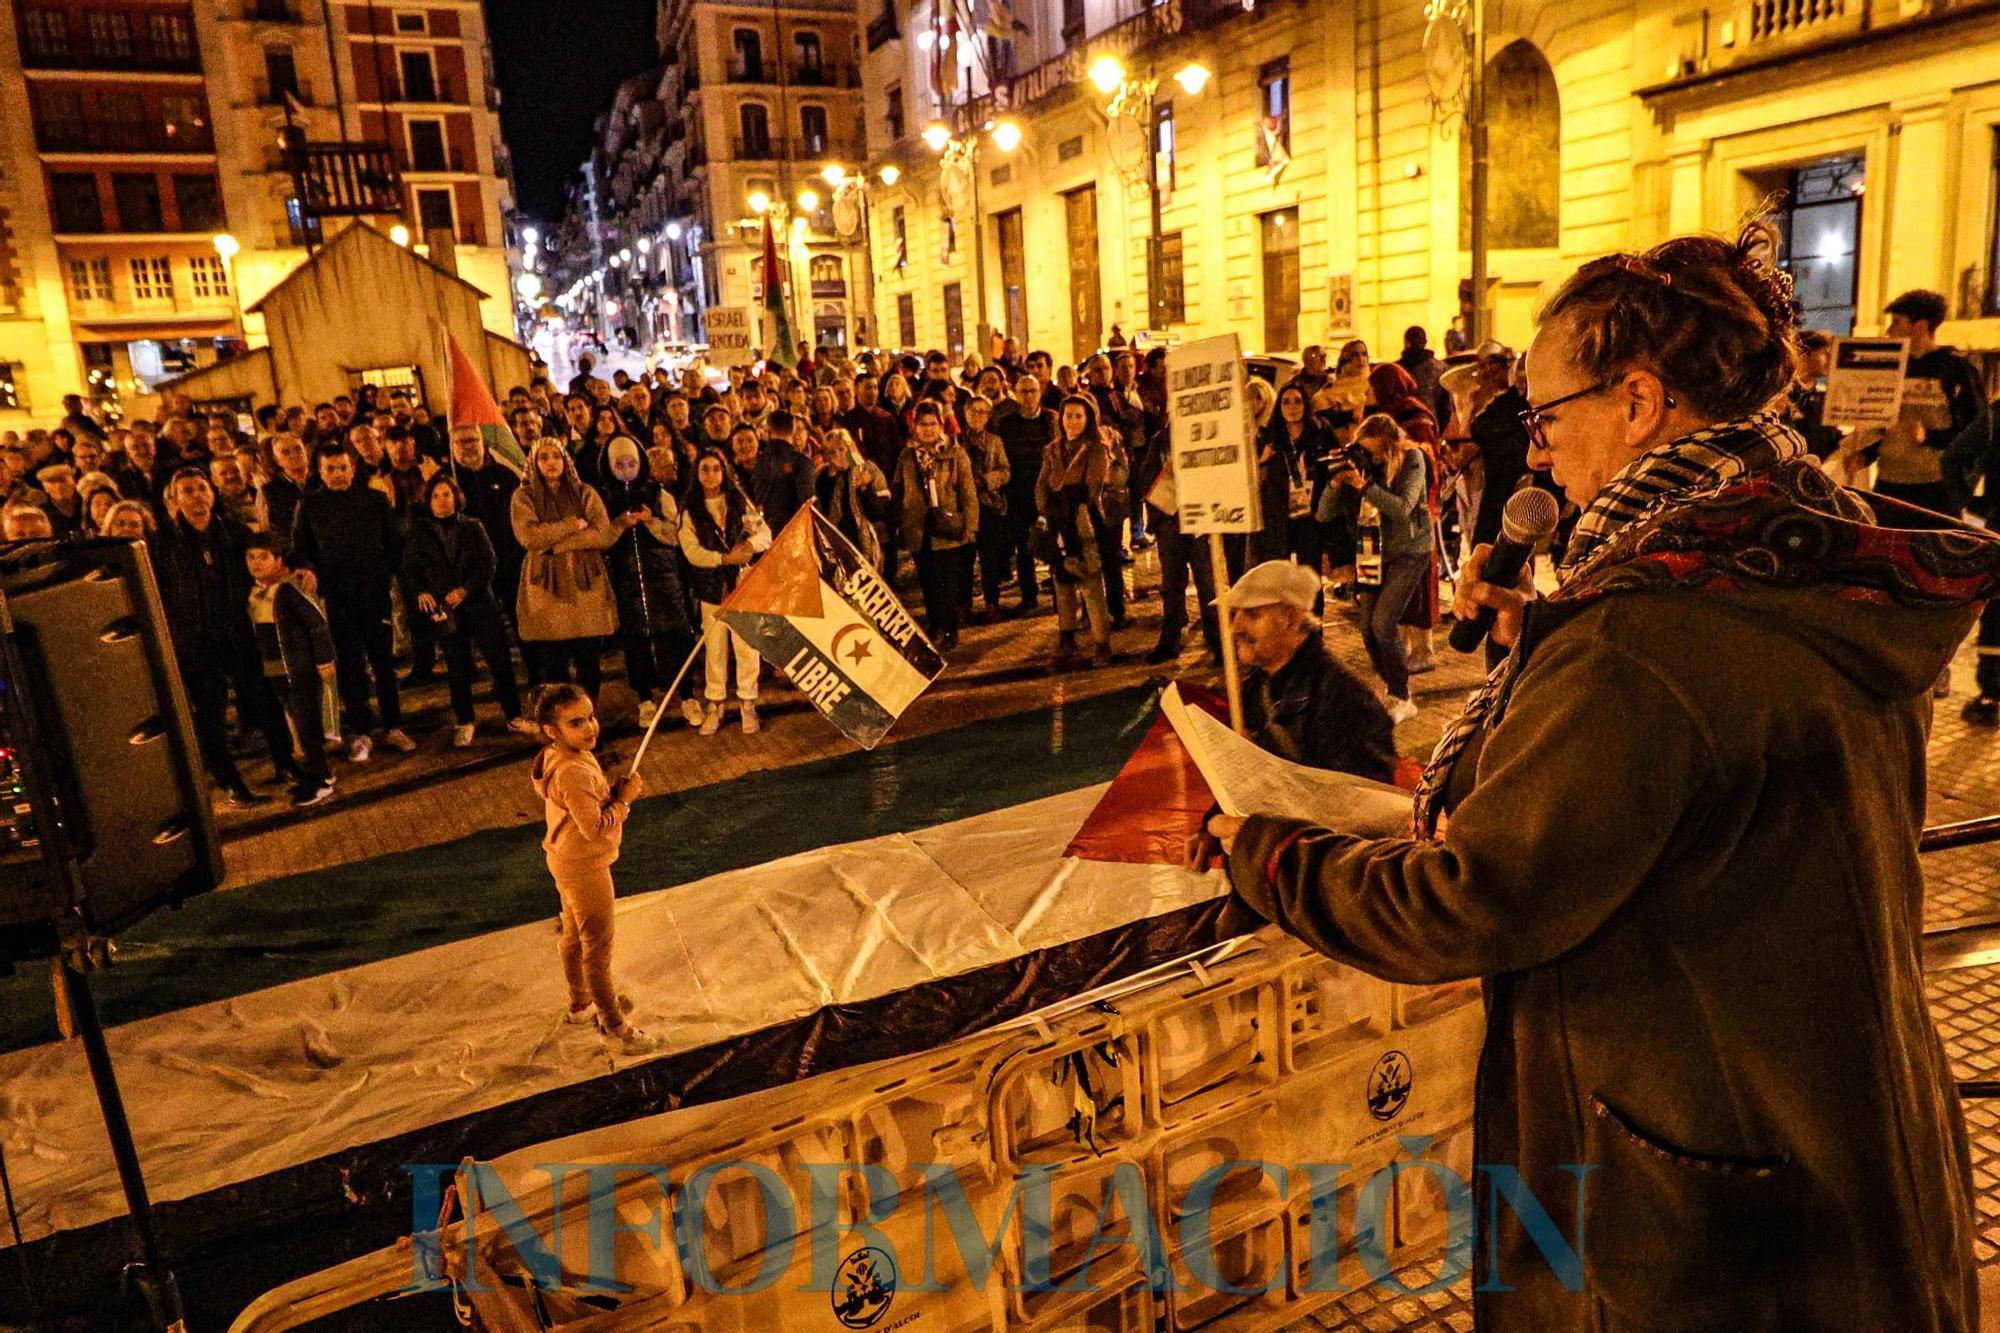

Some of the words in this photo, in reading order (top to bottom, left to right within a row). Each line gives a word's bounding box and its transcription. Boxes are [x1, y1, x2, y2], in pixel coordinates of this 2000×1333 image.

[707, 311, 746, 328] ISRAEL
[844, 568, 917, 649] SAHARA
[783, 646, 852, 715] LIBRE
